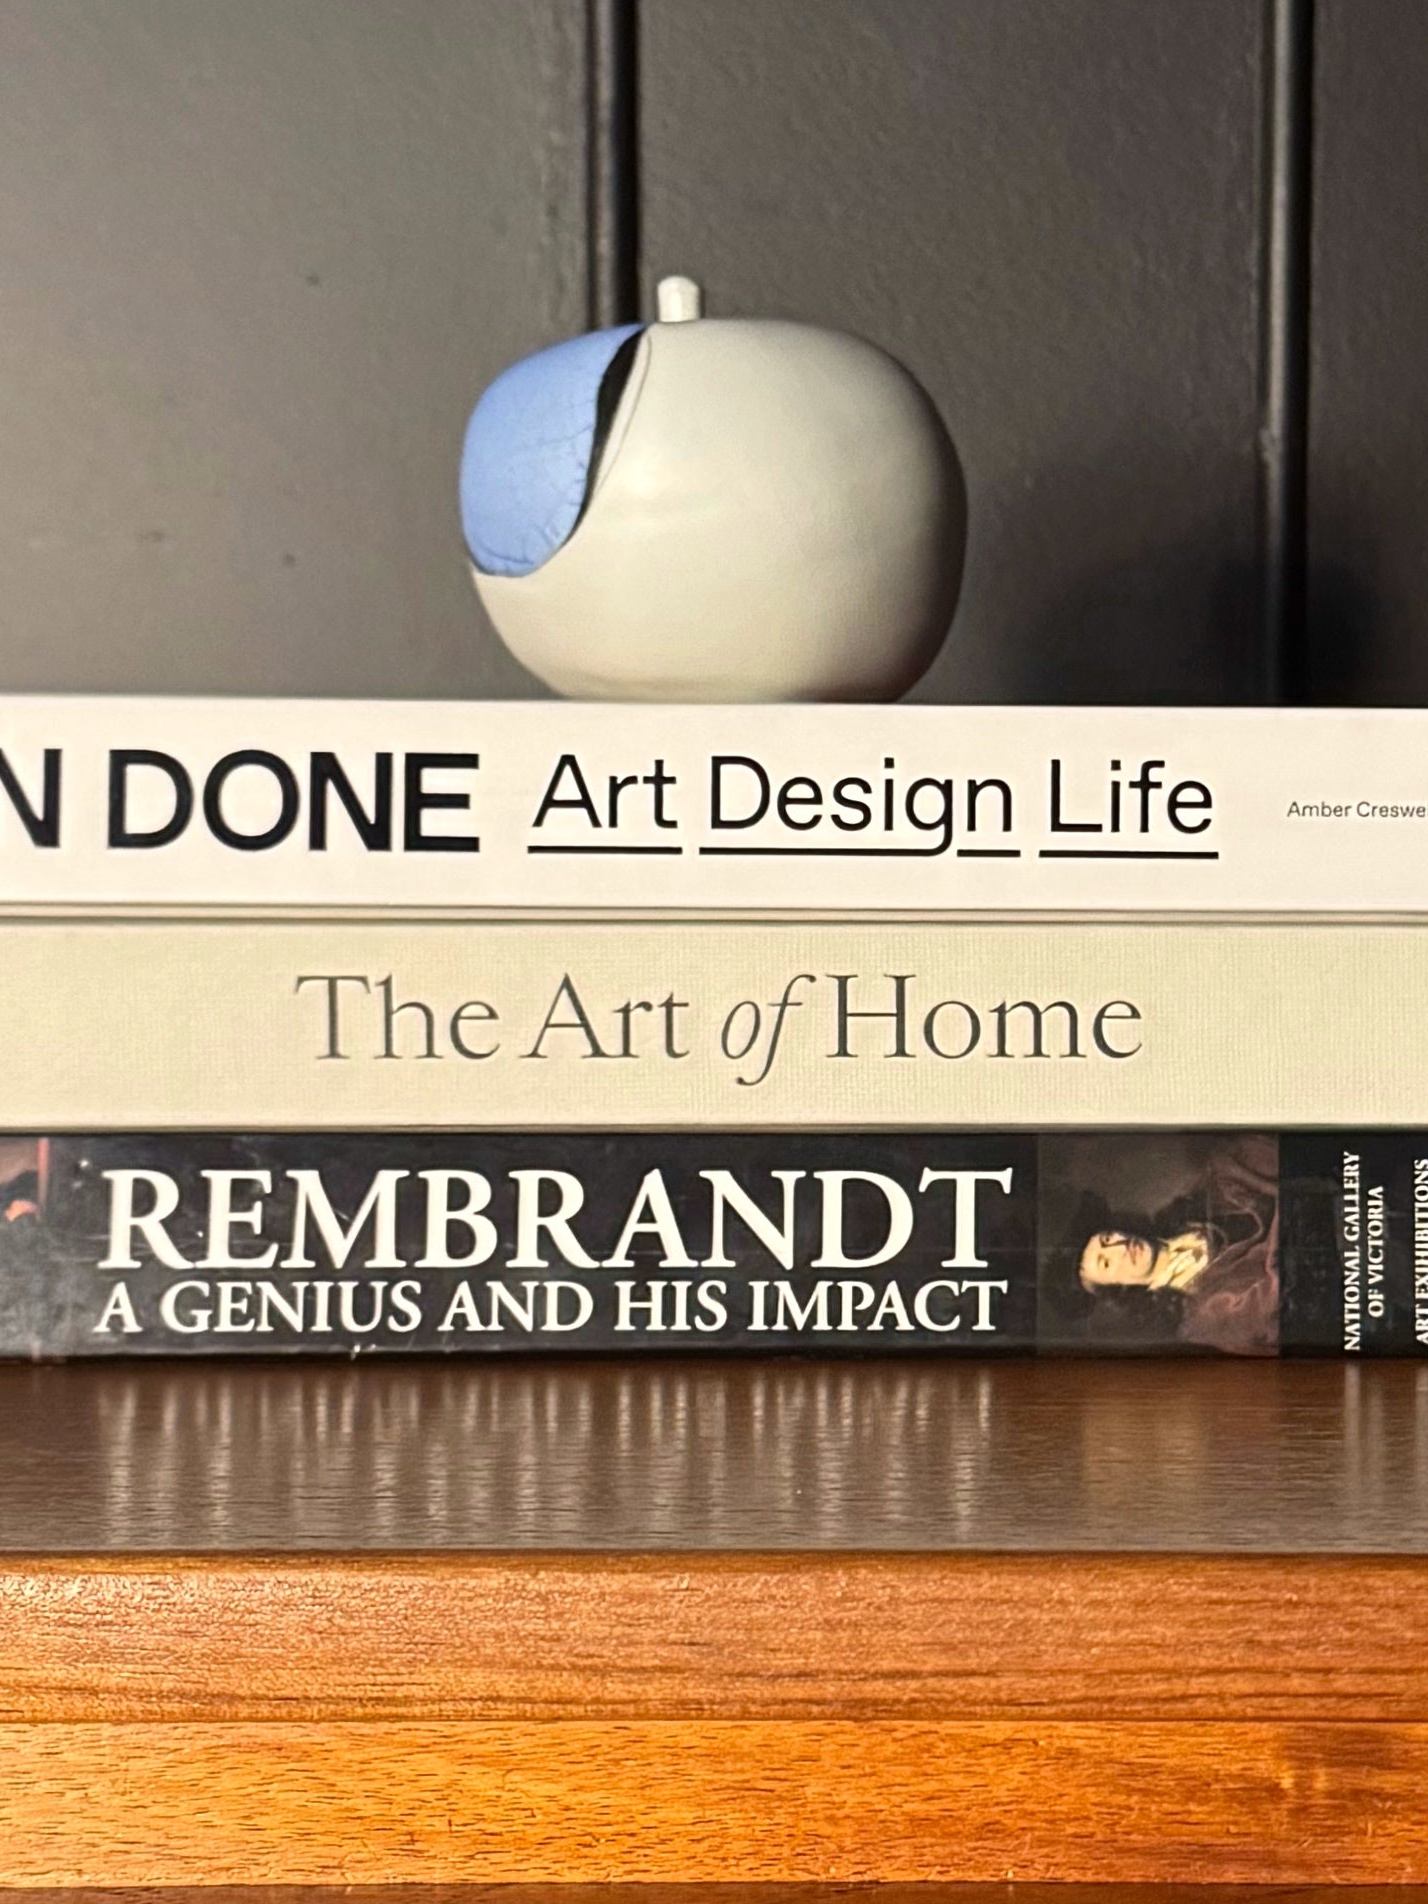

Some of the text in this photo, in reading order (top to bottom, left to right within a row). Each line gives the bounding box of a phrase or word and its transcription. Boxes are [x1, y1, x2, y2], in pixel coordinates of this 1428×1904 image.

[107, 749, 481, 853] DONE
[532, 753, 678, 829] Art
[710, 755, 1012, 851] Design
[1050, 758, 1214, 835] Life
[1286, 800, 1352, 818] Amber
[294, 973, 1144, 1087] The Art of Home
[96, 1167, 1014, 1271] REMBRANDT
[1343, 1151, 1361, 1351] NATIONAL GALLERY
[1367, 1185, 1385, 1318] OF VICTORIA
[92, 1279, 1009, 1334] A GENIUS AND HIS IMPACT
